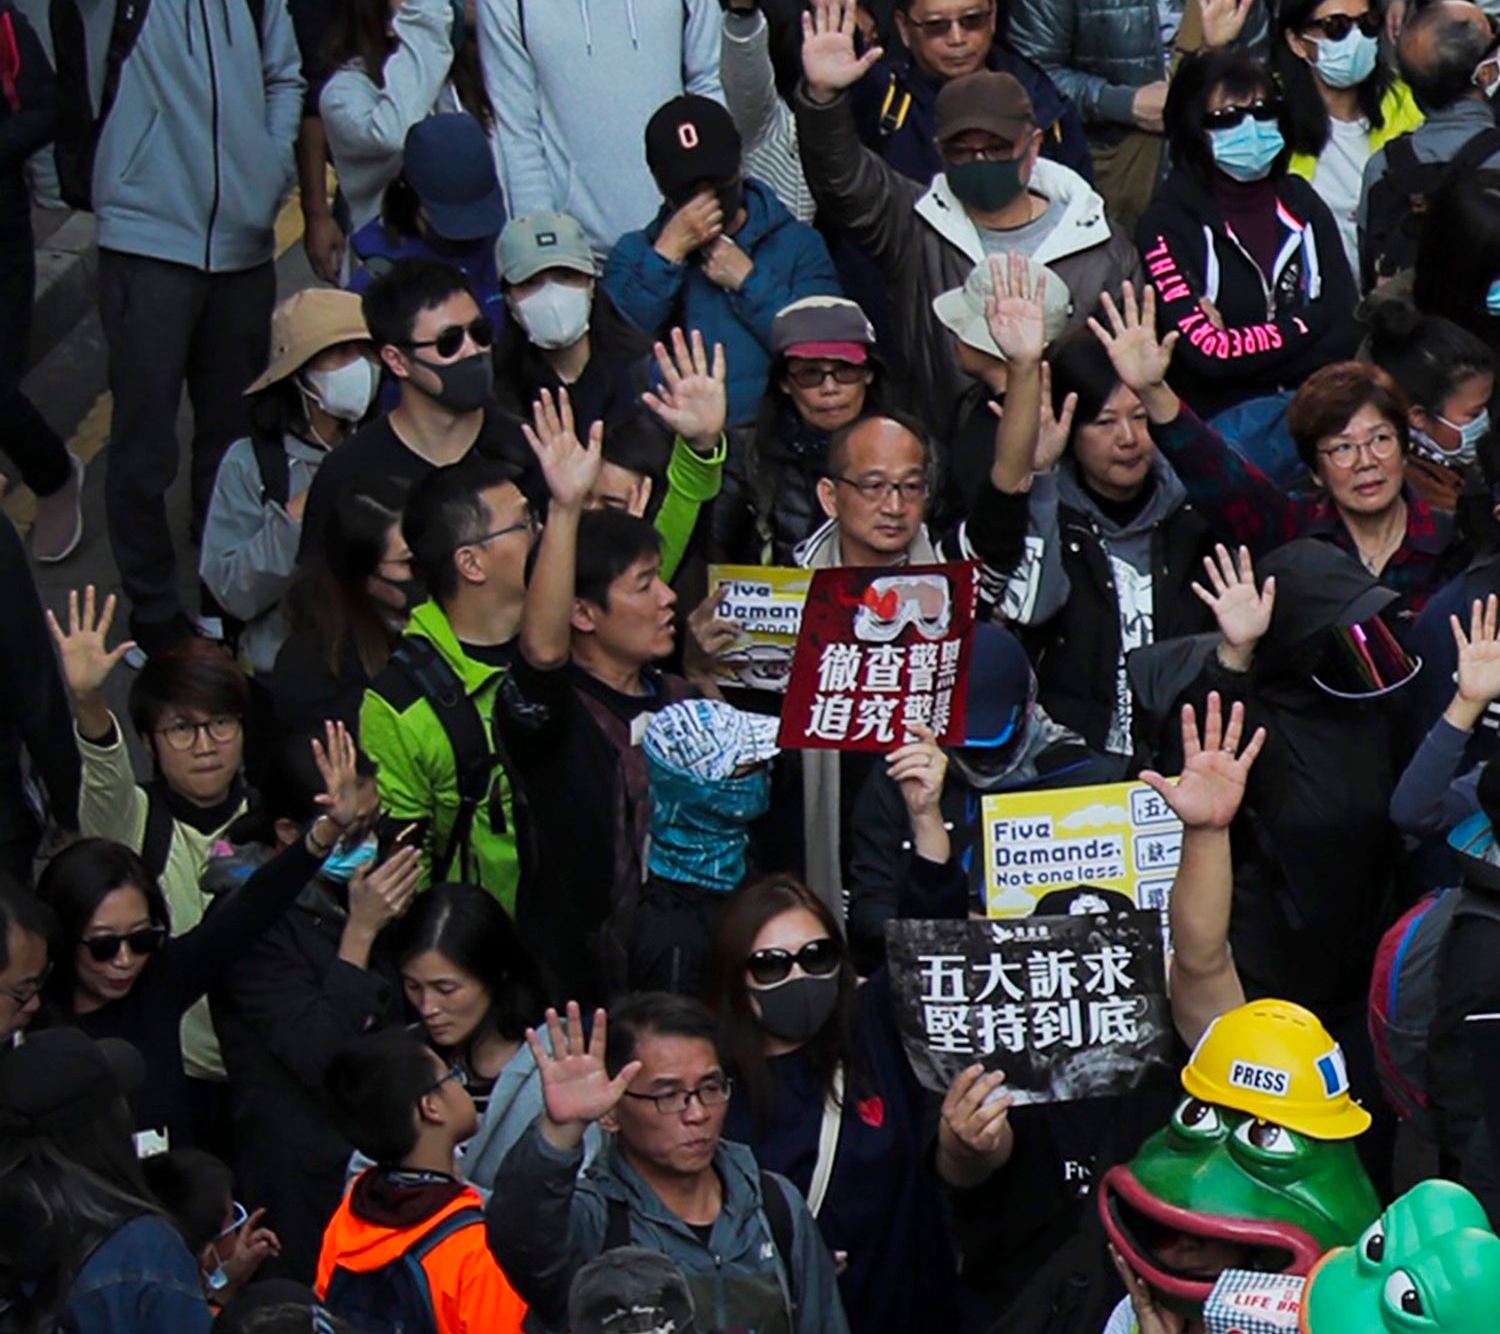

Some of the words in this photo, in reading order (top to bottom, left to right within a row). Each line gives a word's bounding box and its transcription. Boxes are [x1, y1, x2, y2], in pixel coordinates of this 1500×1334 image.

[818, 637, 961, 694] 徹查警黑
[803, 688, 951, 745] 追究警暴
[993, 821, 1051, 842] Five
[997, 869, 1034, 888] Not
[1039, 866, 1075, 885] one
[919, 945, 1136, 1004] 五大訴求
[922, 997, 1139, 1054] 堅持到底
[1232, 1064, 1286, 1093] PRESS
[1234, 1293, 1269, 1309] LIFE
